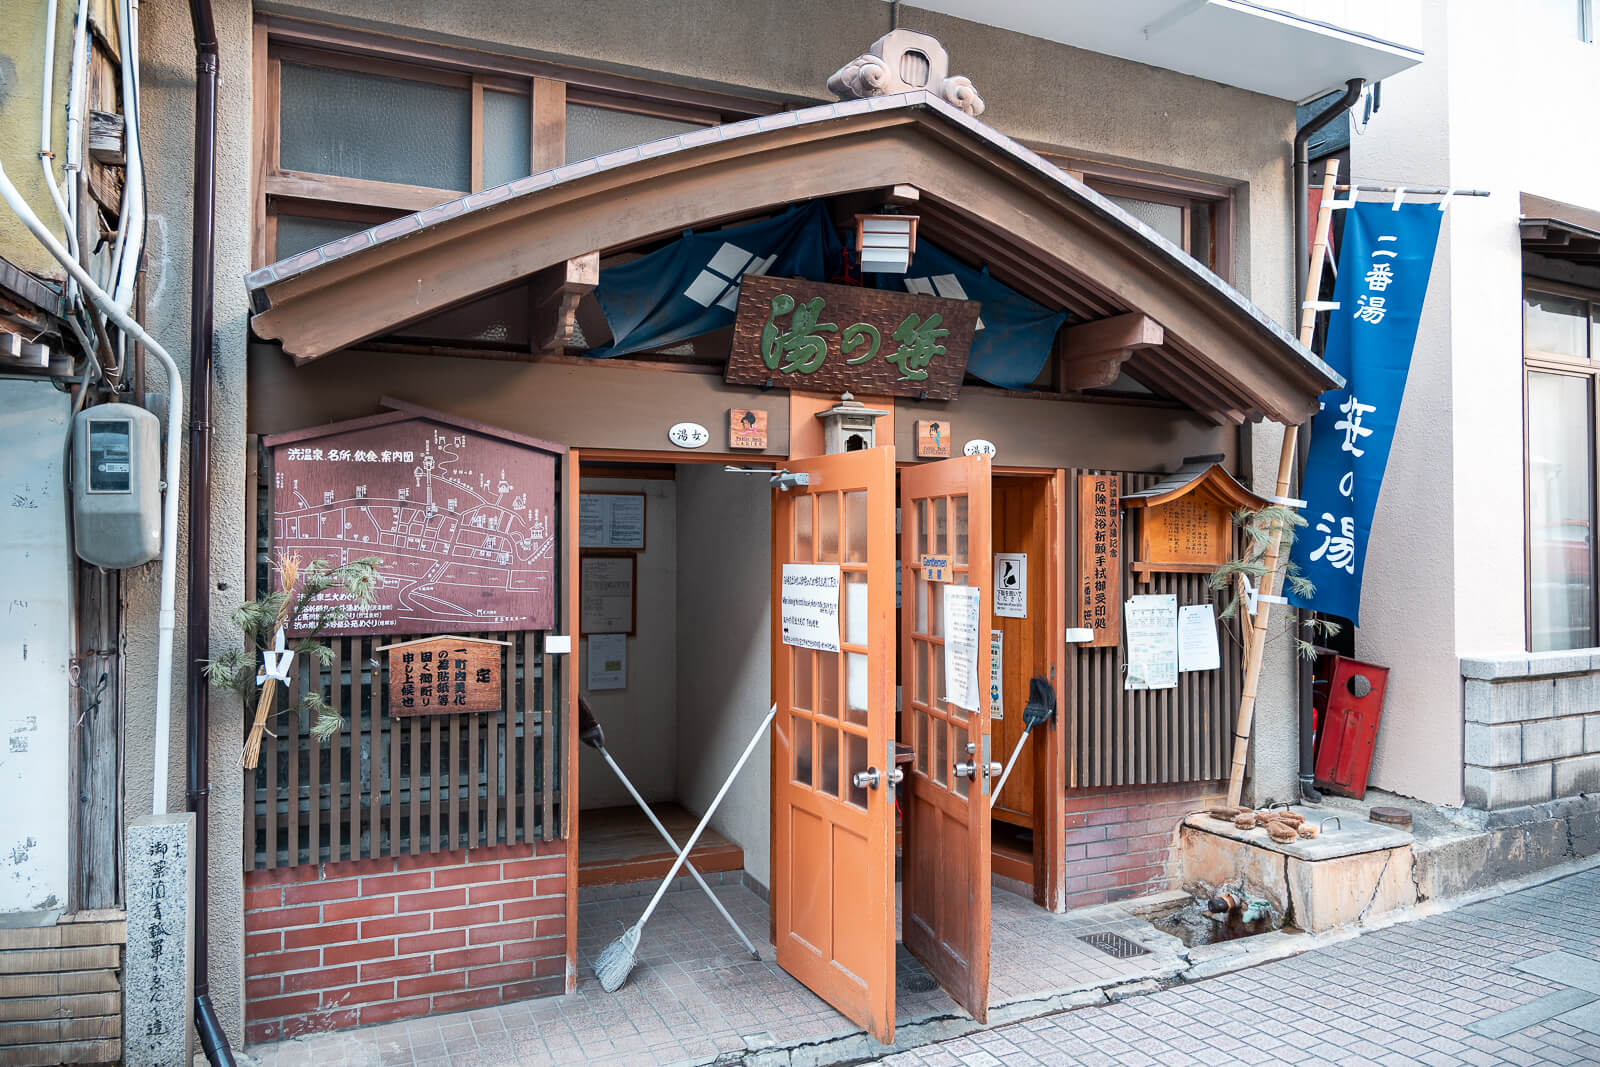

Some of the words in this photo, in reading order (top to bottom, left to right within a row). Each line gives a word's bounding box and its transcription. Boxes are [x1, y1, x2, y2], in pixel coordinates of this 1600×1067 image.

[1353, 234, 1398, 325] 二番湯
[401, 652, 415, 708] 申し上候也
[476, 668, 491, 683] 定
